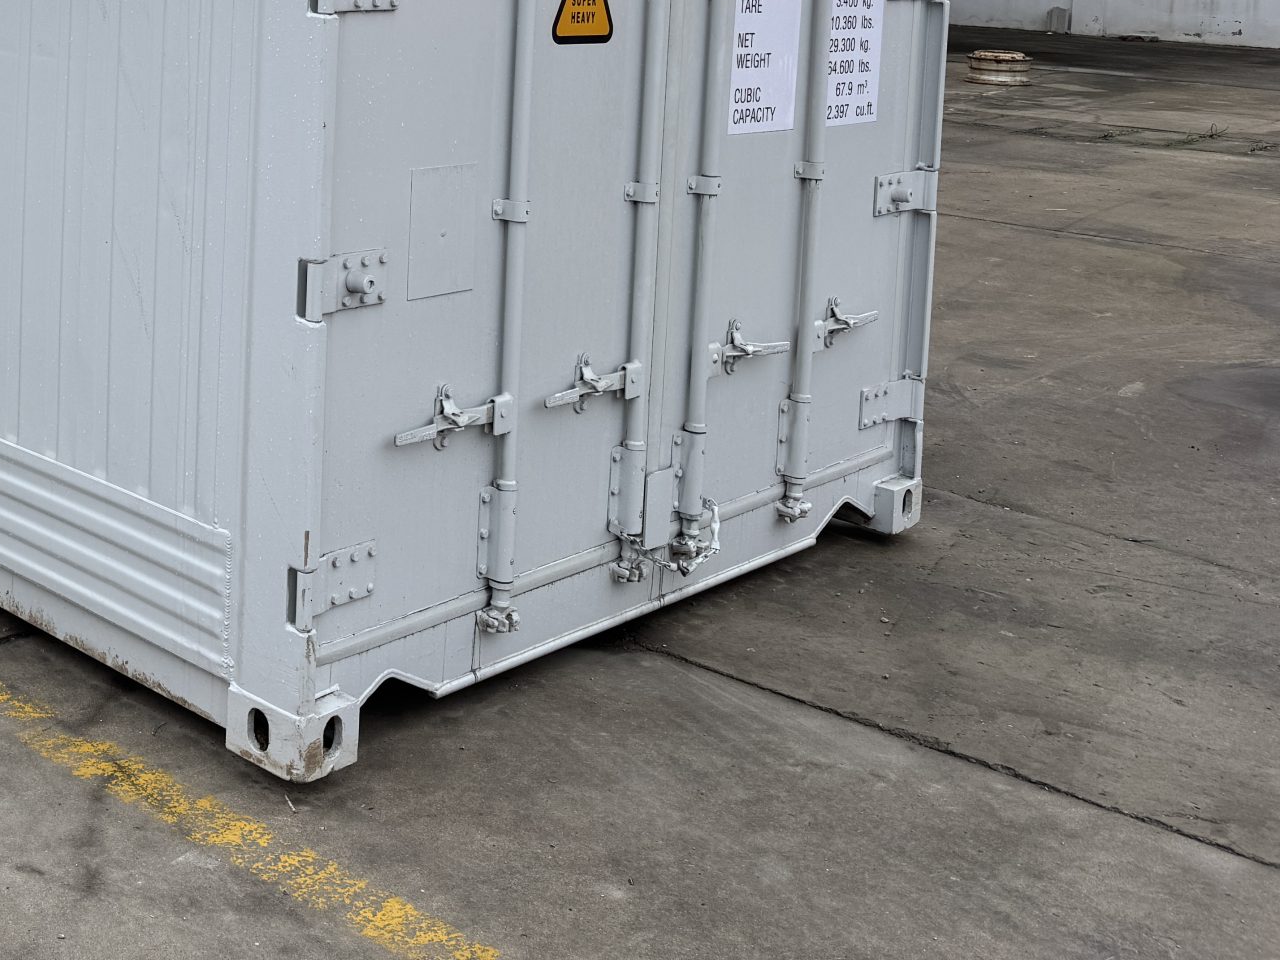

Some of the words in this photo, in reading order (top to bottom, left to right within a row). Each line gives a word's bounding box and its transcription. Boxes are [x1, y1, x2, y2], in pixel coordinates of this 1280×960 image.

[571, 12, 596, 24] HEAVY
[861, 15, 874, 29] lbs.
[737, 33, 755, 48] NET
[859, 37, 871, 53] kg.
[736, 53, 772, 69] WEIGHT
[858, 59, 871, 73] lbs.
[734, 87, 761, 103] CUBIC
[835, 81, 853, 96] 67.9
[733, 107, 776, 124] CAPACITY
[827, 104, 849, 120] 2.397
